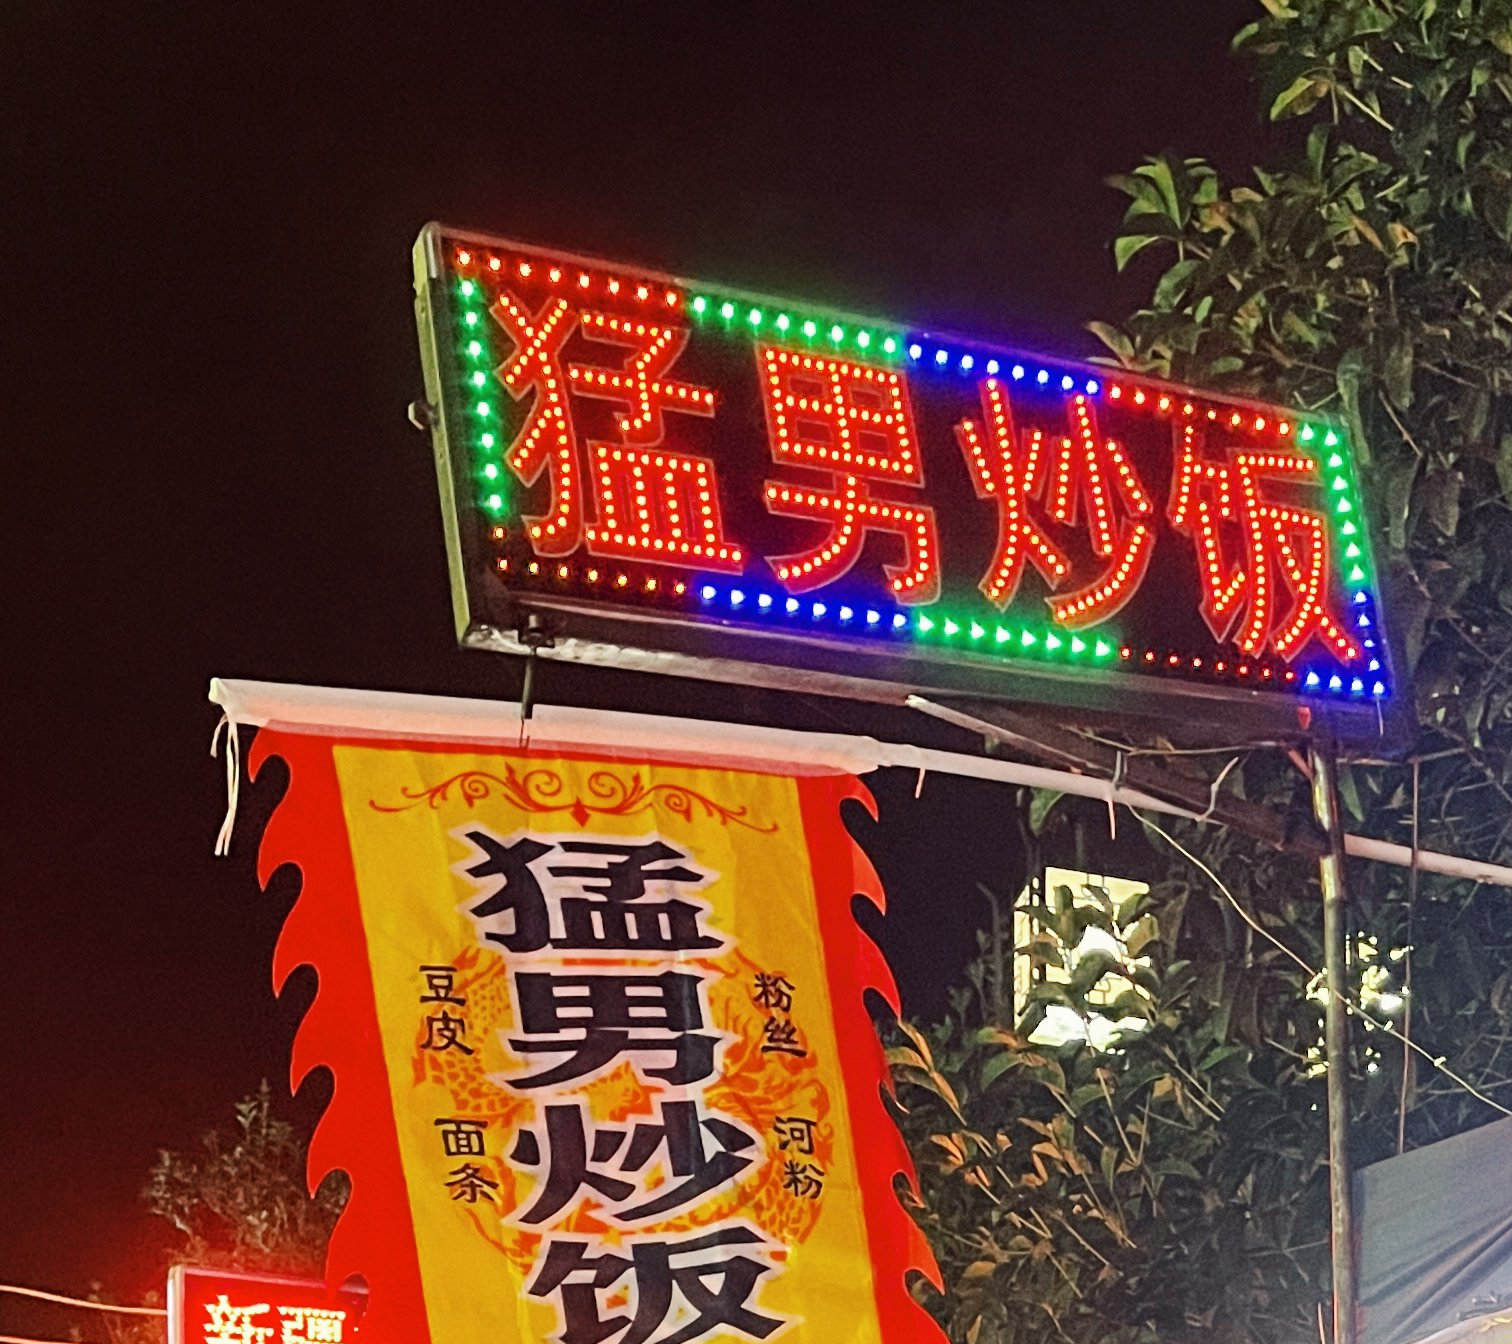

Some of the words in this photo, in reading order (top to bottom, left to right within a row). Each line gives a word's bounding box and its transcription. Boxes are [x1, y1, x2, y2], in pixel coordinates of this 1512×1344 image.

[491, 290, 1360, 661] 猛男炒饭
[417, 964, 475, 1055] 豆皮
[753, 972, 808, 1058] 粉丝
[433, 1117, 501, 1204] 面条
[772, 1115, 827, 1199] 河粉
